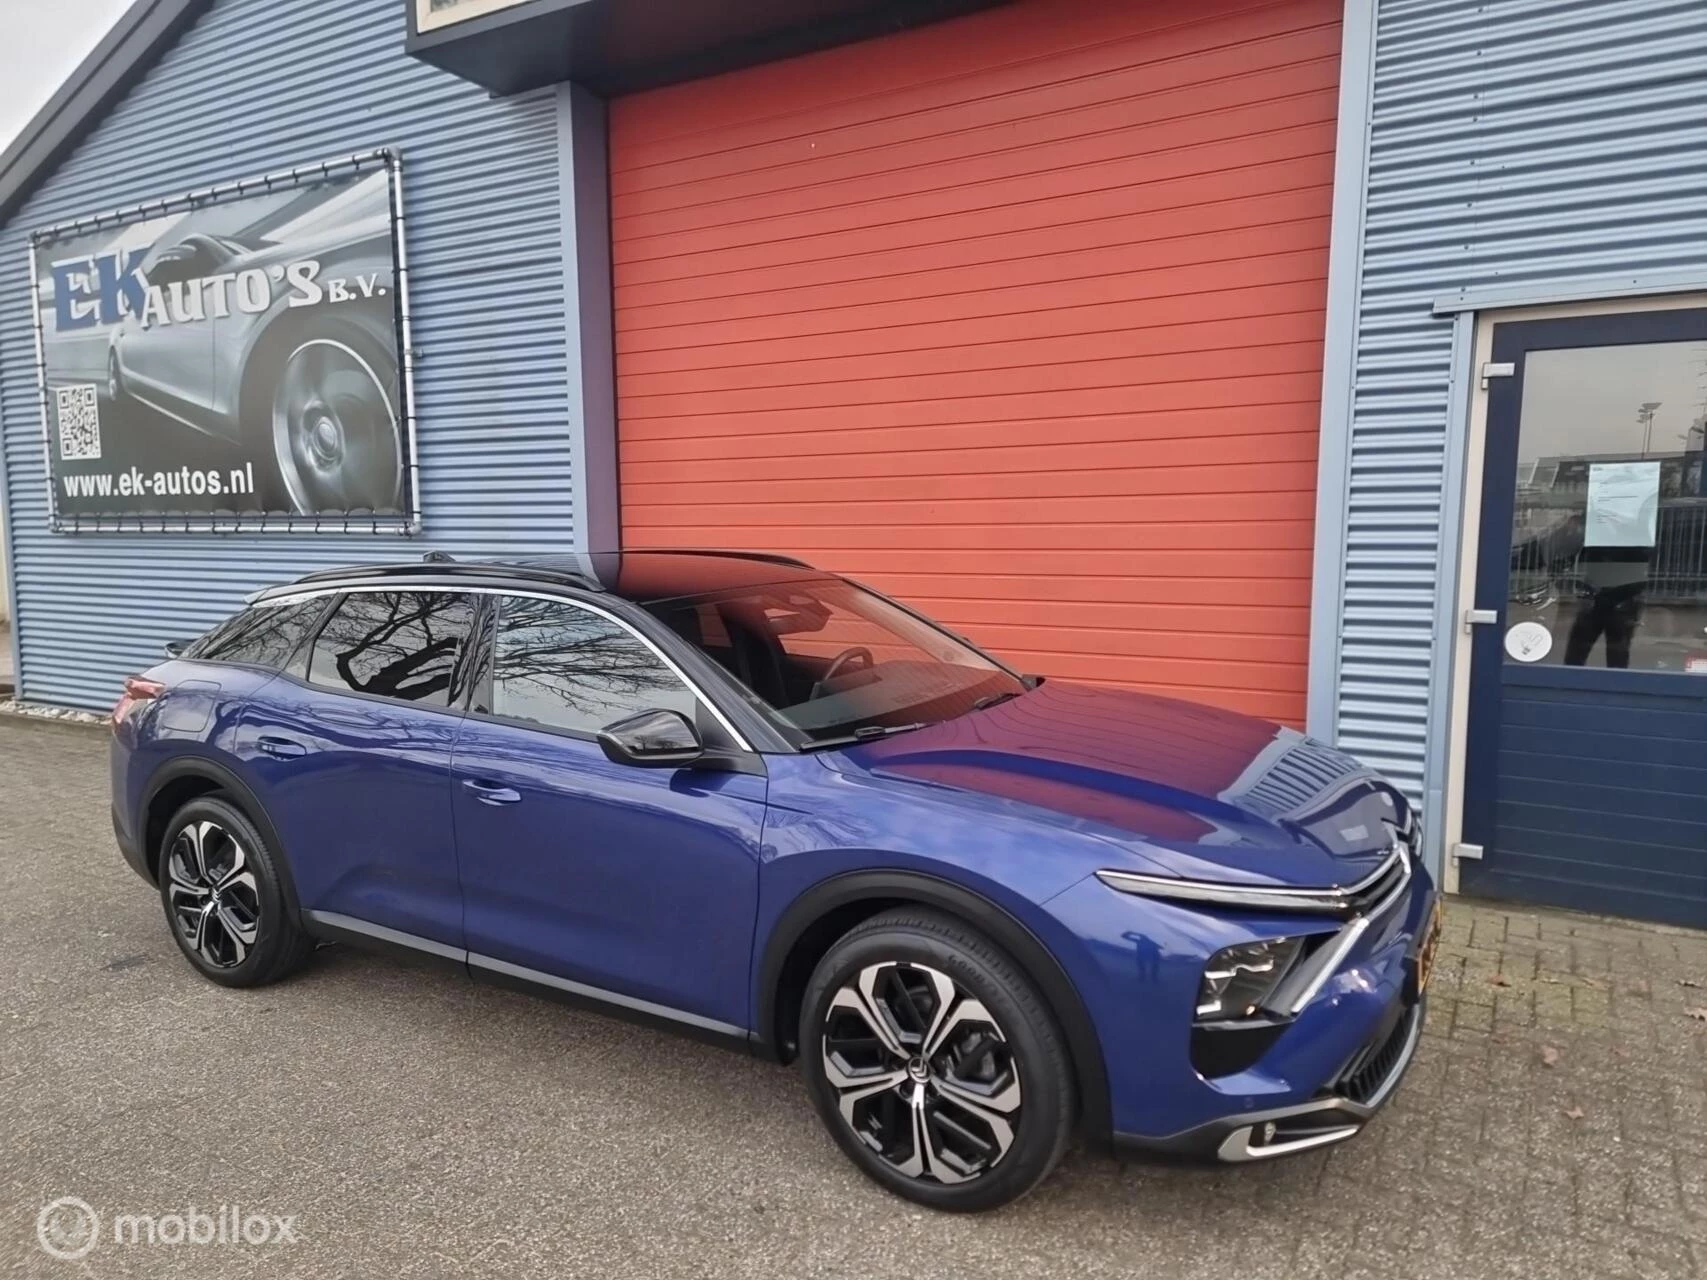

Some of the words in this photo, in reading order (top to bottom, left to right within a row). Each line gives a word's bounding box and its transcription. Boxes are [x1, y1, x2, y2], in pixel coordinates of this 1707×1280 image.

[52, 246, 152, 332] EK
[140, 260, 323, 332] AUTO'S
[328, 272, 387, 304] B.V.
[64, 462, 254, 498] www.ek-autos.nl
